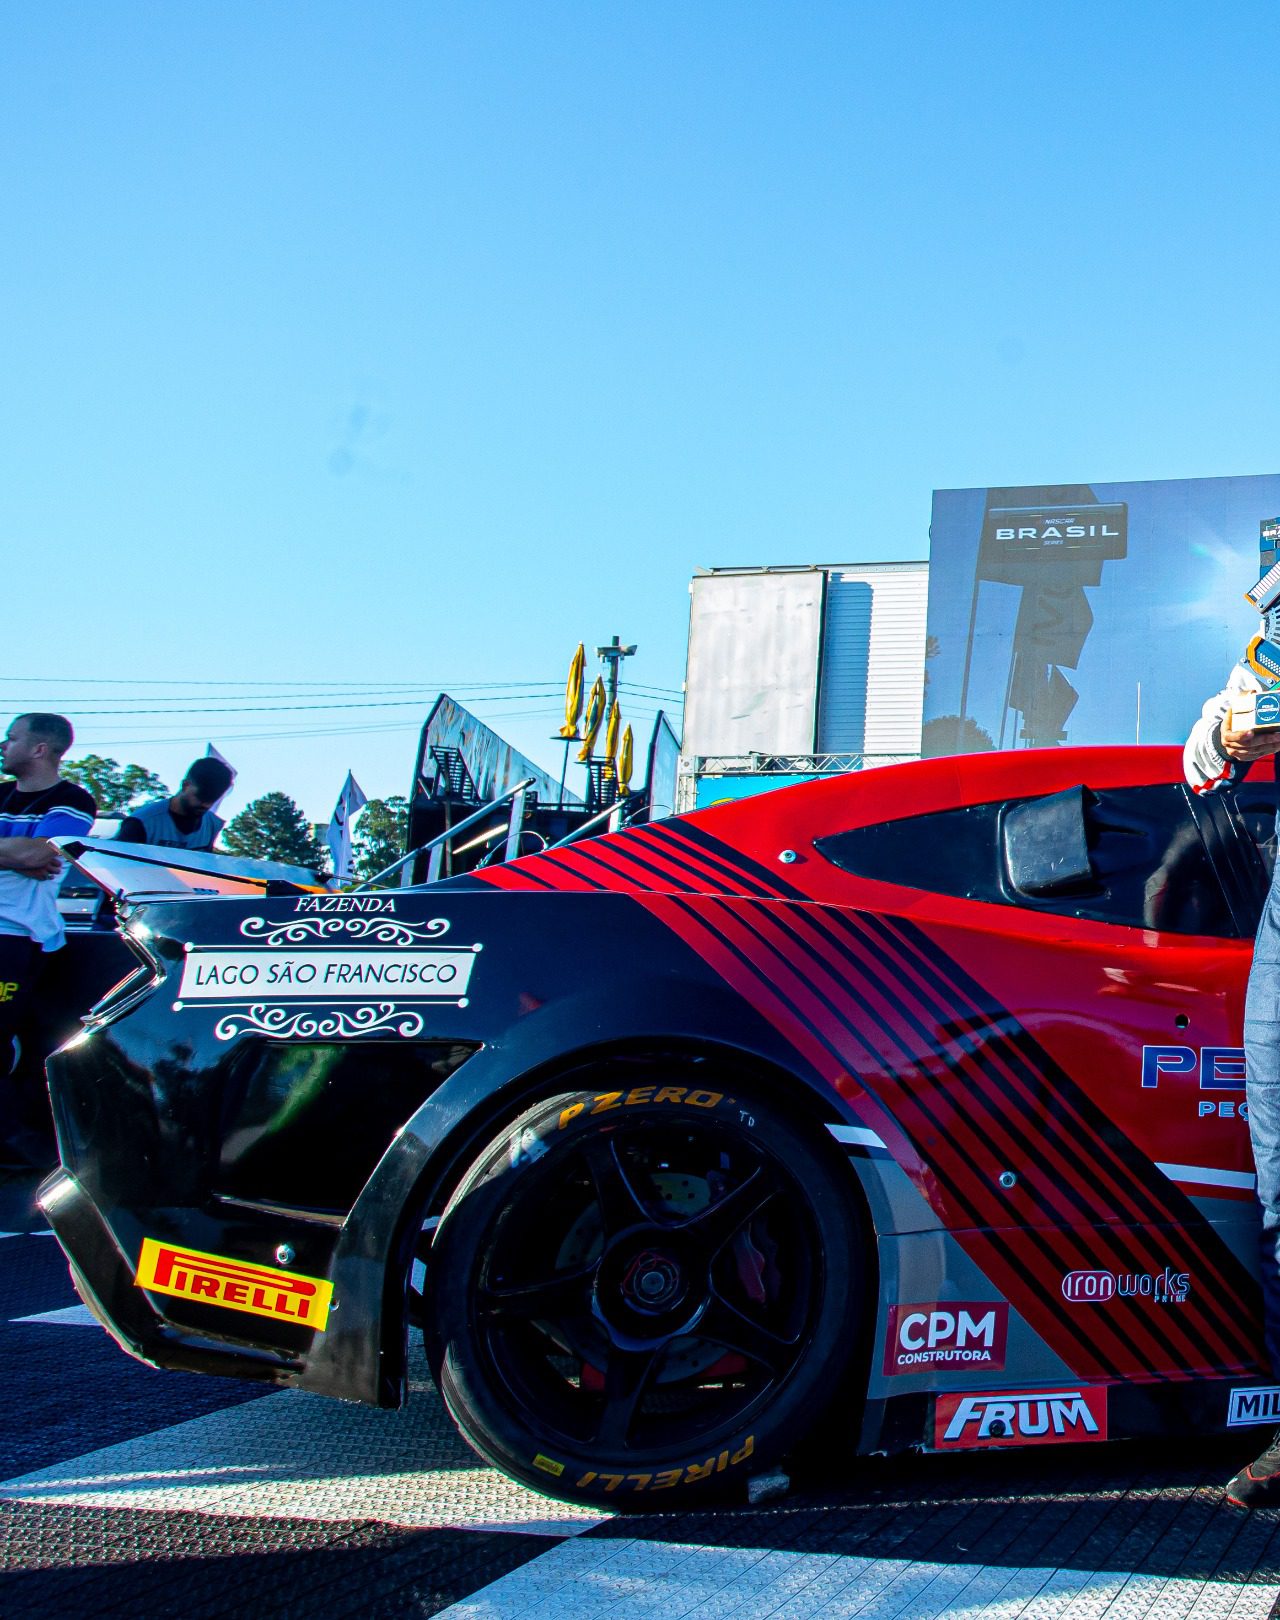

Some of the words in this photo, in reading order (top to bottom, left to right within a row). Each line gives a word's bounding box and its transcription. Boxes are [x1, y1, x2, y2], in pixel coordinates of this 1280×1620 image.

[995, 525, 1120, 540] BRASIL
[293, 897, 396, 912] FAZENDA
[195, 964, 259, 986] LAGO
[266, 960, 317, 985] SÃO
[323, 963, 457, 984] FRANCISCO
[557, 1103, 585, 1130] P
[590, 1085, 724, 1116] ZERO
[153, 1248, 317, 1319] PIRELLI
[899, 1311, 996, 1350] CPM
[897, 1350, 991, 1365] CONSTRUTORA
[943, 1392, 1098, 1439] FRUM
[576, 1434, 755, 1491] PIRELLI
